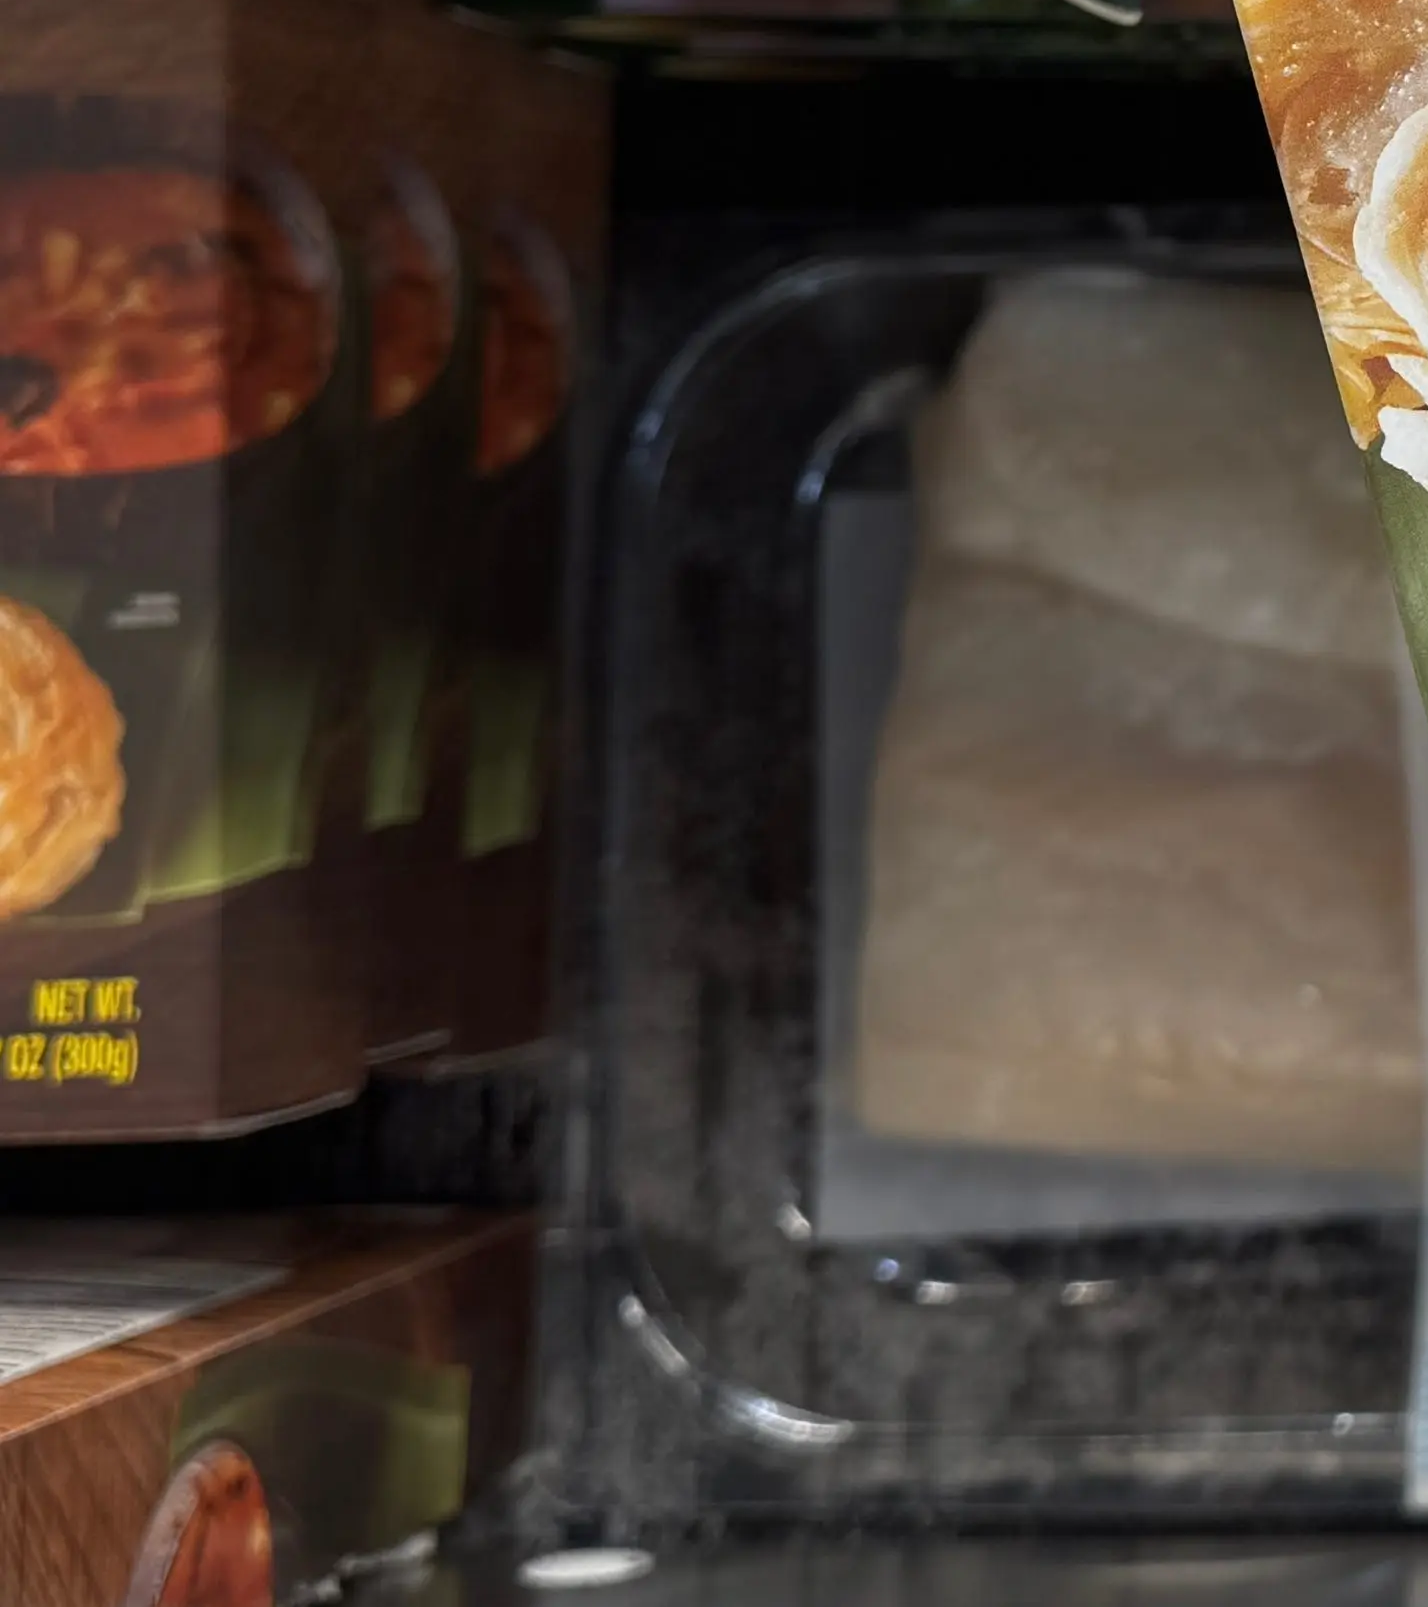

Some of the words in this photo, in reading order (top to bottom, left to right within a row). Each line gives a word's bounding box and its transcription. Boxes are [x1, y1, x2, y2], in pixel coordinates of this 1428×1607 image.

[34, 978, 89, 1026] NET
[94, 976, 141, 1023] WT.
[6, 1032, 47, 1080] OZ
[51, 1029, 139, 1087] (300g)
